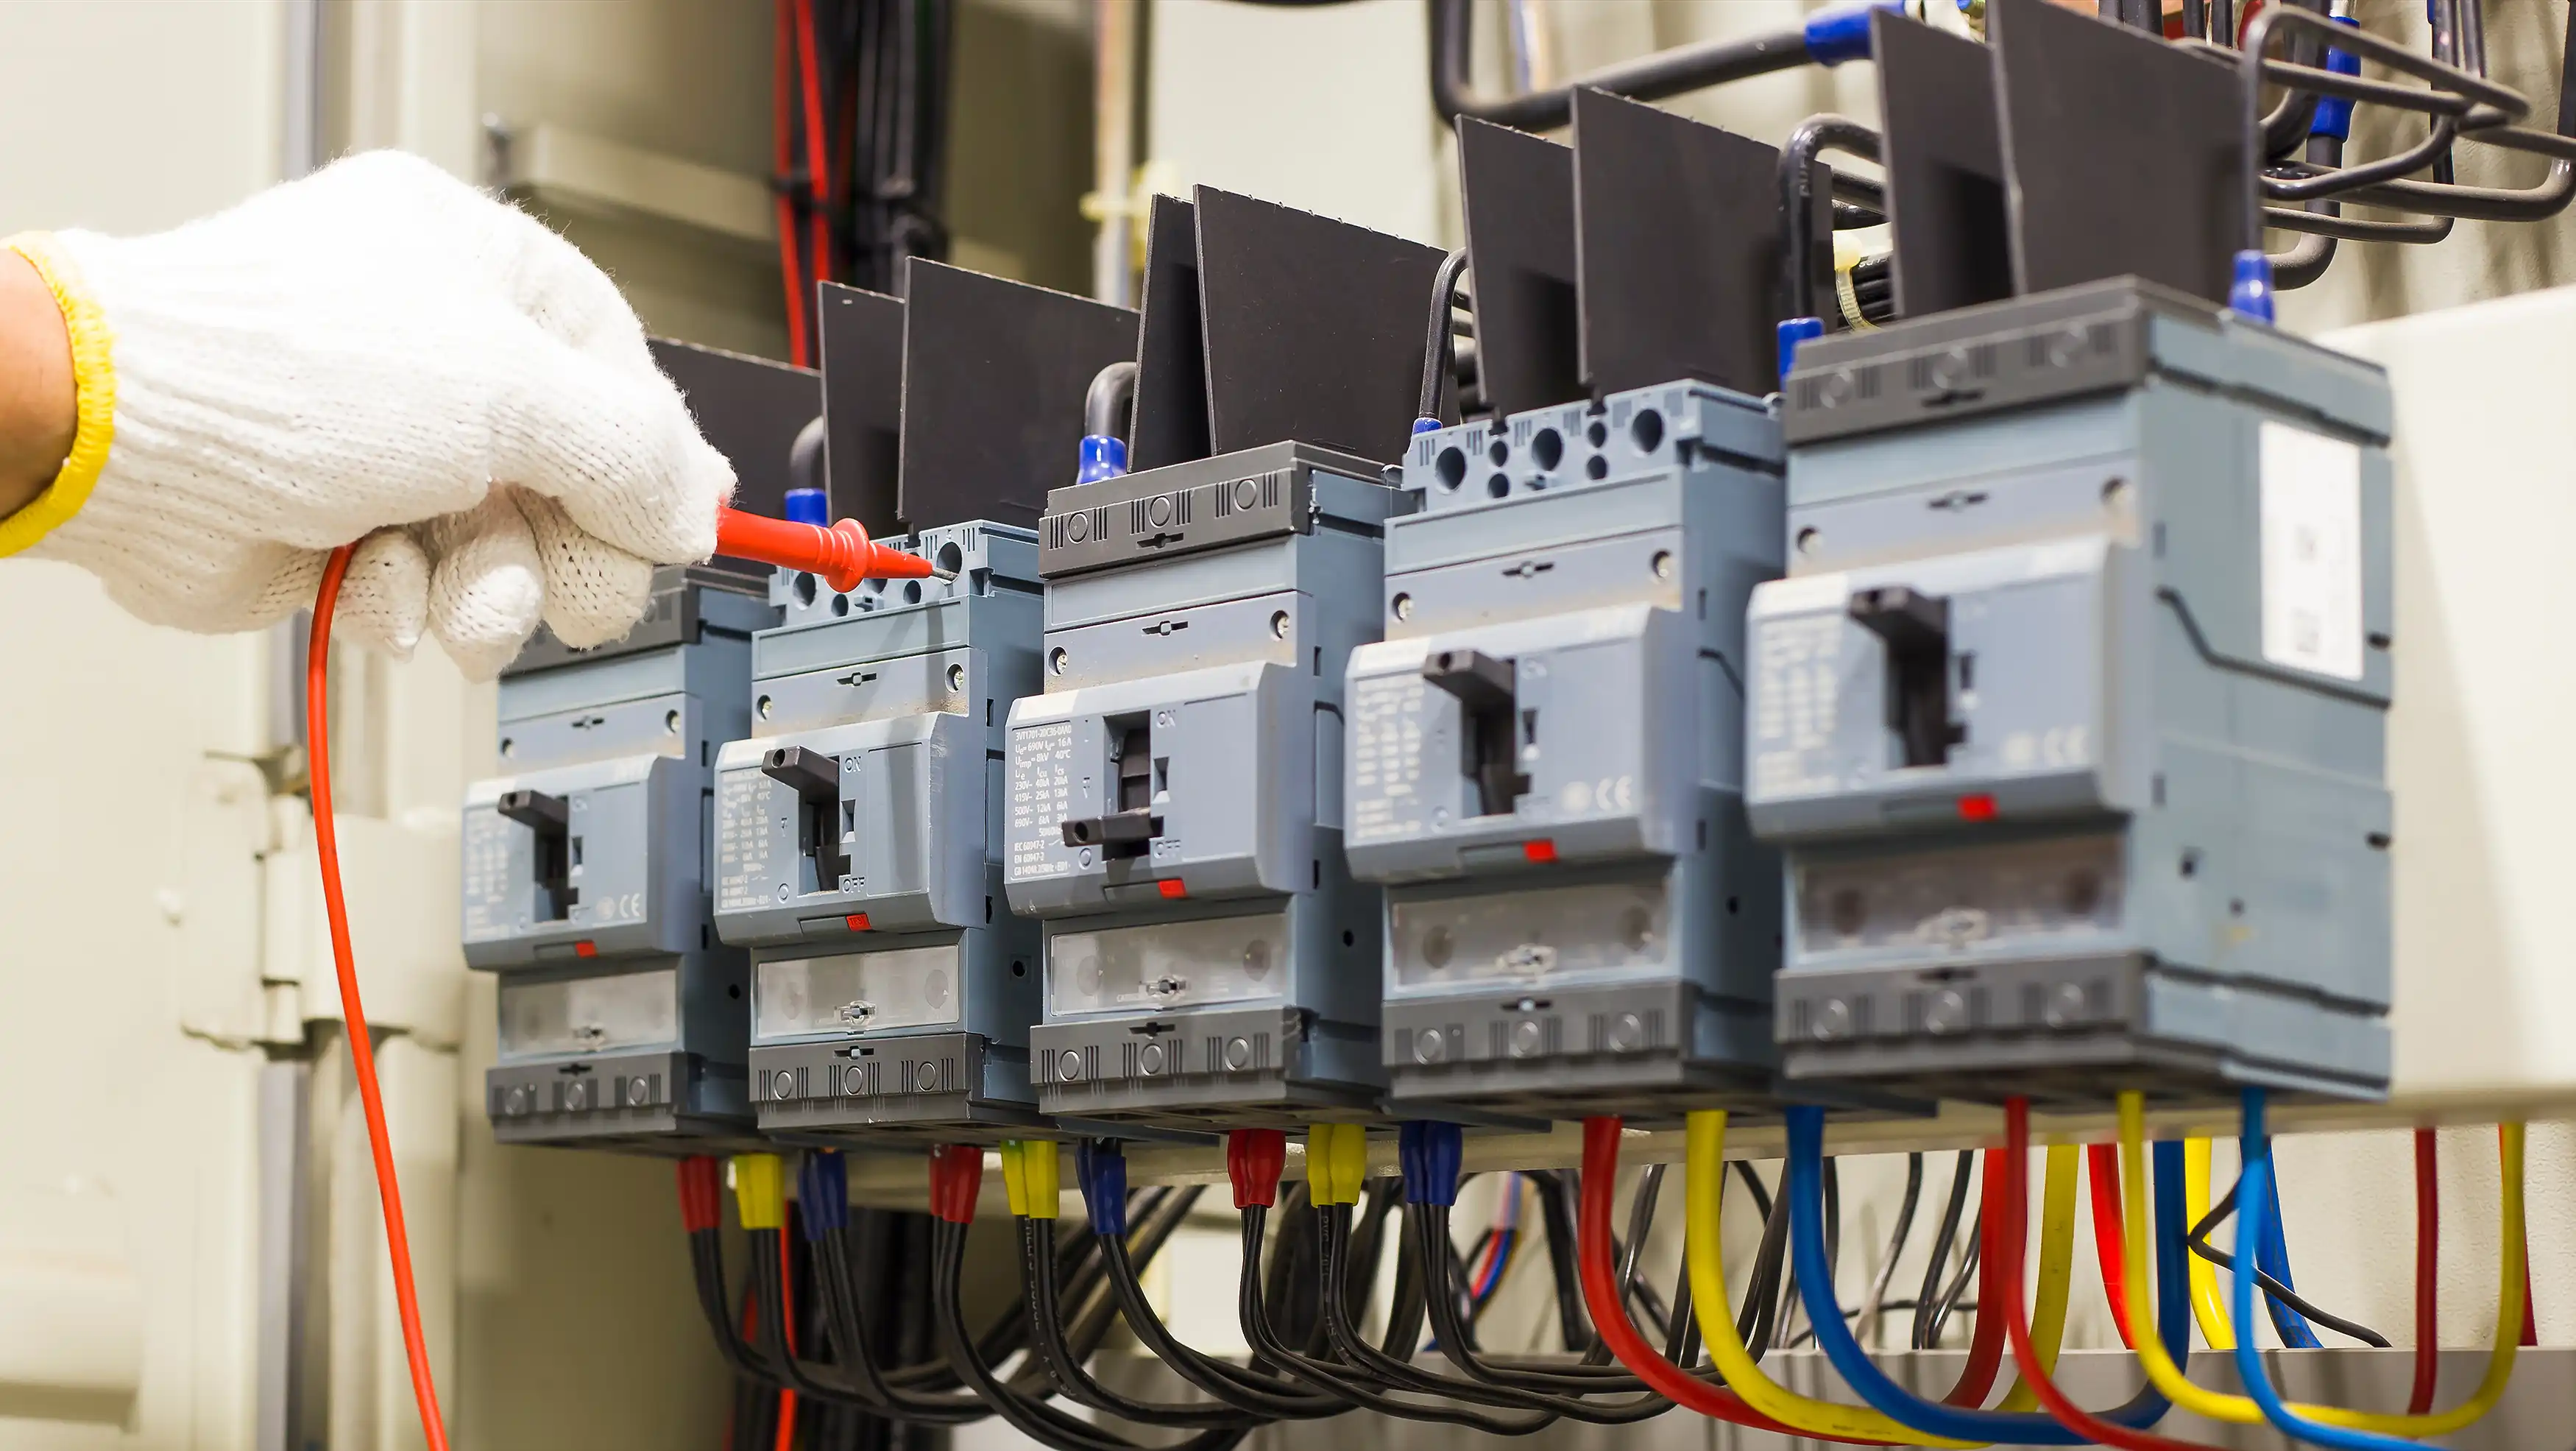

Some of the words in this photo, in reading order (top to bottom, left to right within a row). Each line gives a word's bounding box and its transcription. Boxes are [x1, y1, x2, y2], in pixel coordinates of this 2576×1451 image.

[1058, 736, 1072, 747] 16A
[844, 755, 862, 774] ON
[1014, 842, 1022, 852] IEC
[843, 876, 866, 894] OFF
[619, 893, 640, 918] CE
